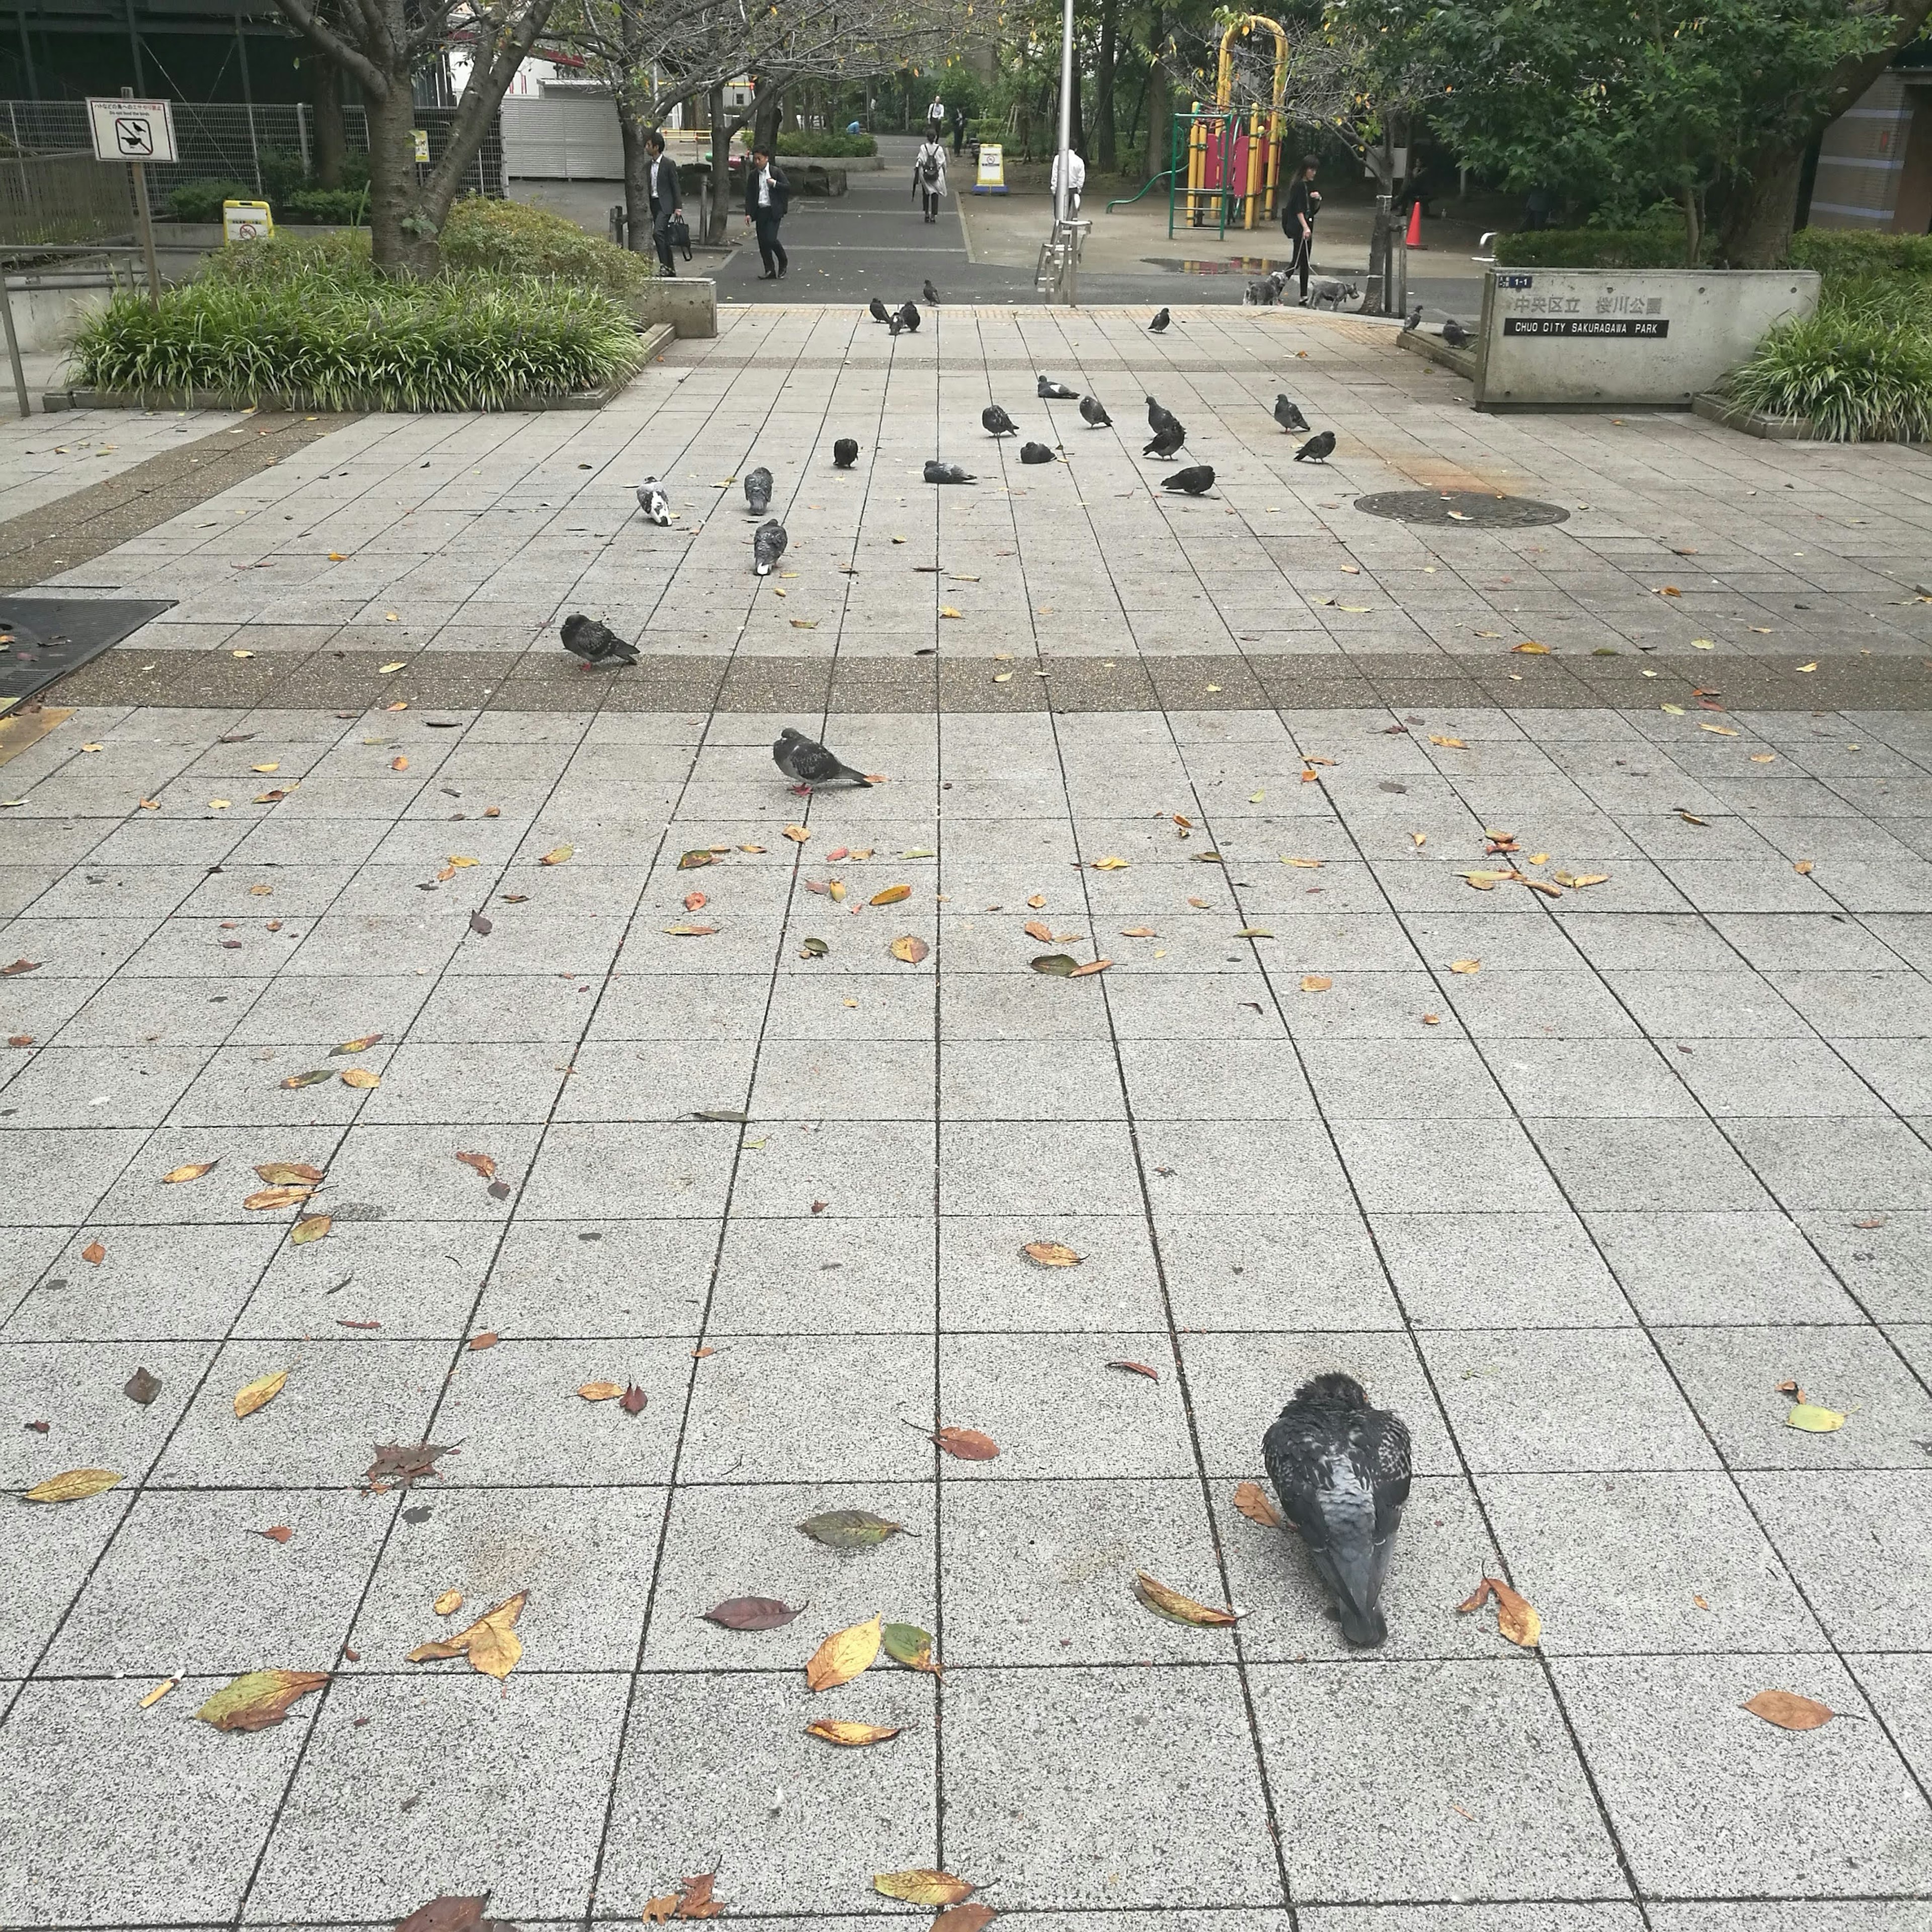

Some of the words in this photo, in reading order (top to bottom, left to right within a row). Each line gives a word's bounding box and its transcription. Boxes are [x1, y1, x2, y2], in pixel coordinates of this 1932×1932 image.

[1514, 295, 1581, 313] 中央区立
[1515, 322, 1538, 332] CHUO
[1543, 323, 1566, 333] CITY
[1572, 323, 1627, 334] SAKURAGAWA
[1635, 324, 1658, 334] PARK
